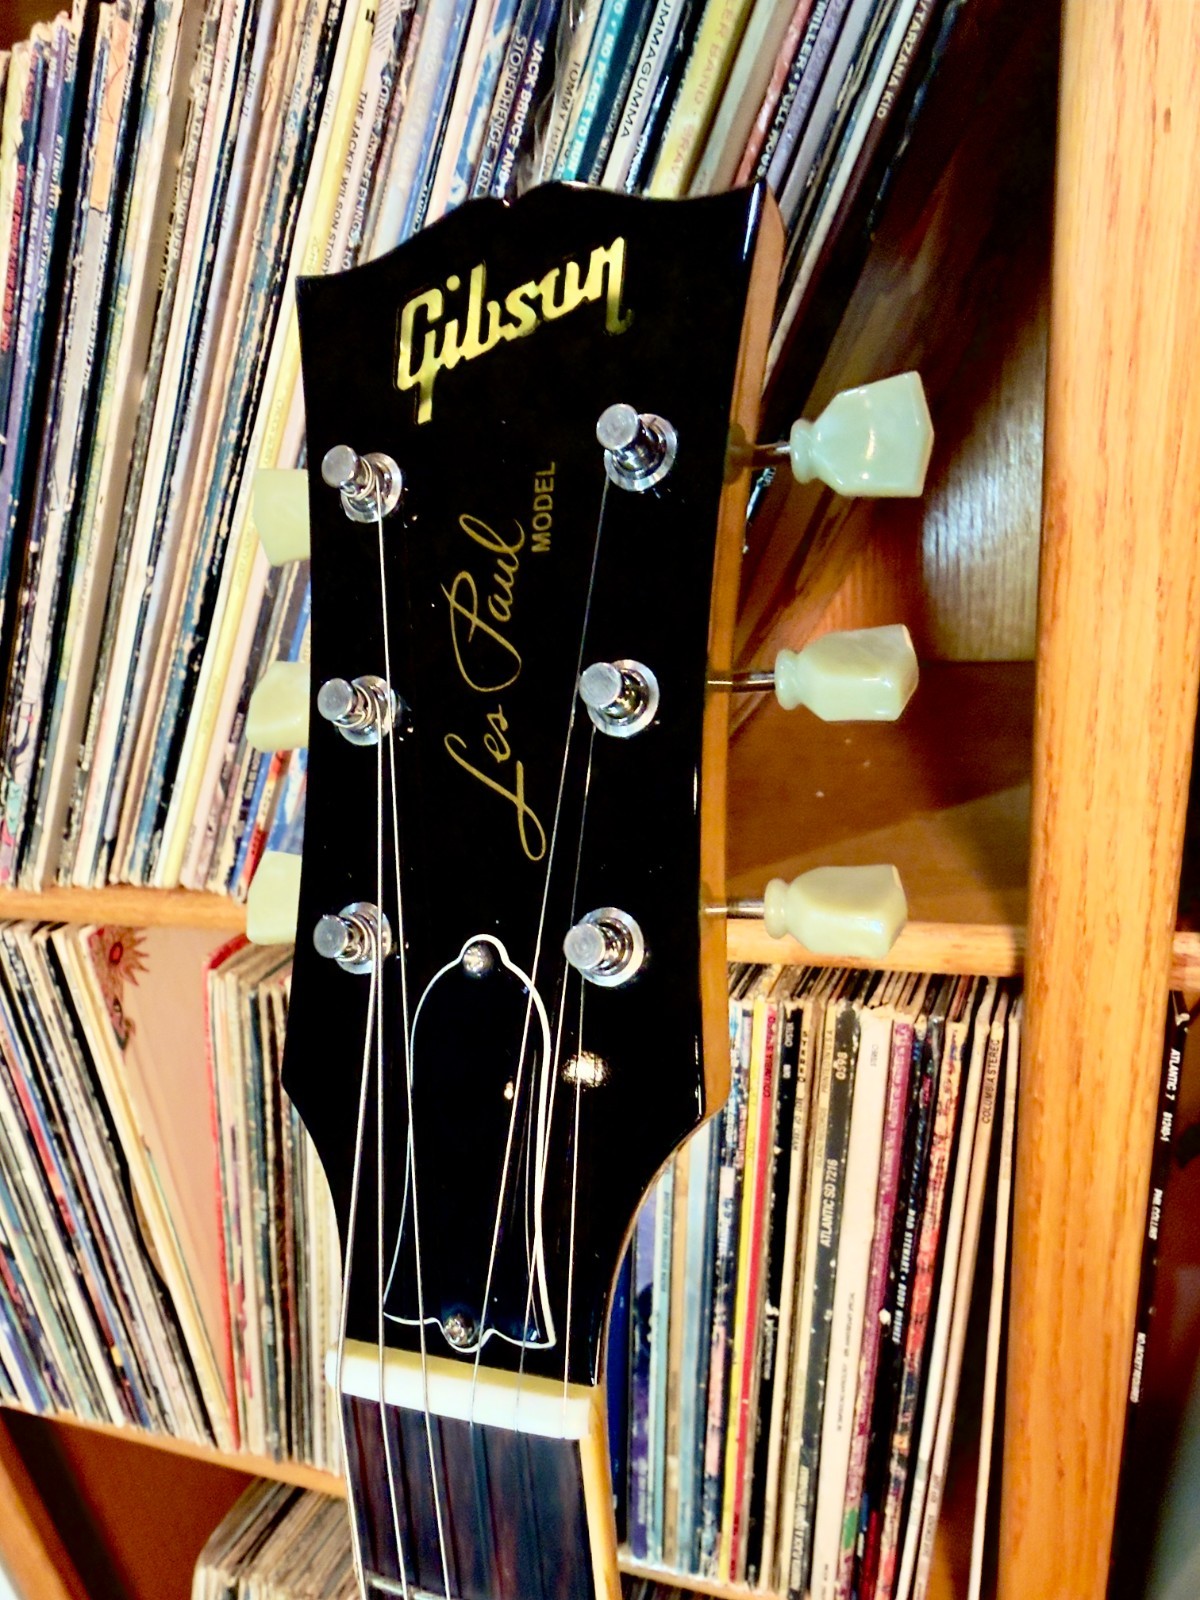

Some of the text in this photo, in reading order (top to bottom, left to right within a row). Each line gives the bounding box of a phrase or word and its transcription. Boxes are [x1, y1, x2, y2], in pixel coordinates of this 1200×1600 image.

[598, 32, 616, 60] NO
[794, 0, 827, 70] MILLER
[556, 59, 581, 121] TOMMY
[583, 59, 608, 112] PLACE
[692, 42, 723, 106] BAND
[476, 33, 526, 188] STONEDHENGE TEN
[495, 38, 545, 186] JACK BRUCE AND
[575, 113, 592, 139] TO
[774, 81, 798, 127] FULL
[875, 89, 895, 120] KID
[565, 138, 585, 173] RUN
[755, 128, 781, 178] HOUS
[320, 90, 367, 275] THE JACKIE WILSON STORY
[395, 236, 633, 424] Gibson
[531, 461, 556, 553] MODEL
[440, 513, 547, 861] Les Paul
[763, 1052, 772, 1097] COLUMBIA
[820, 1058, 832, 1093] PRINTED
[1165, 1046, 1180, 1092] ATLANTIC
[981, 1077, 995, 1125] COLUMBIA
[821, 1158, 838, 1248] ATLANTIC SD 7216
[905, 1207, 916, 1229] ROD
[899, 1230, 913, 1274] STEWART
[895, 1282, 907, 1308] BODY
